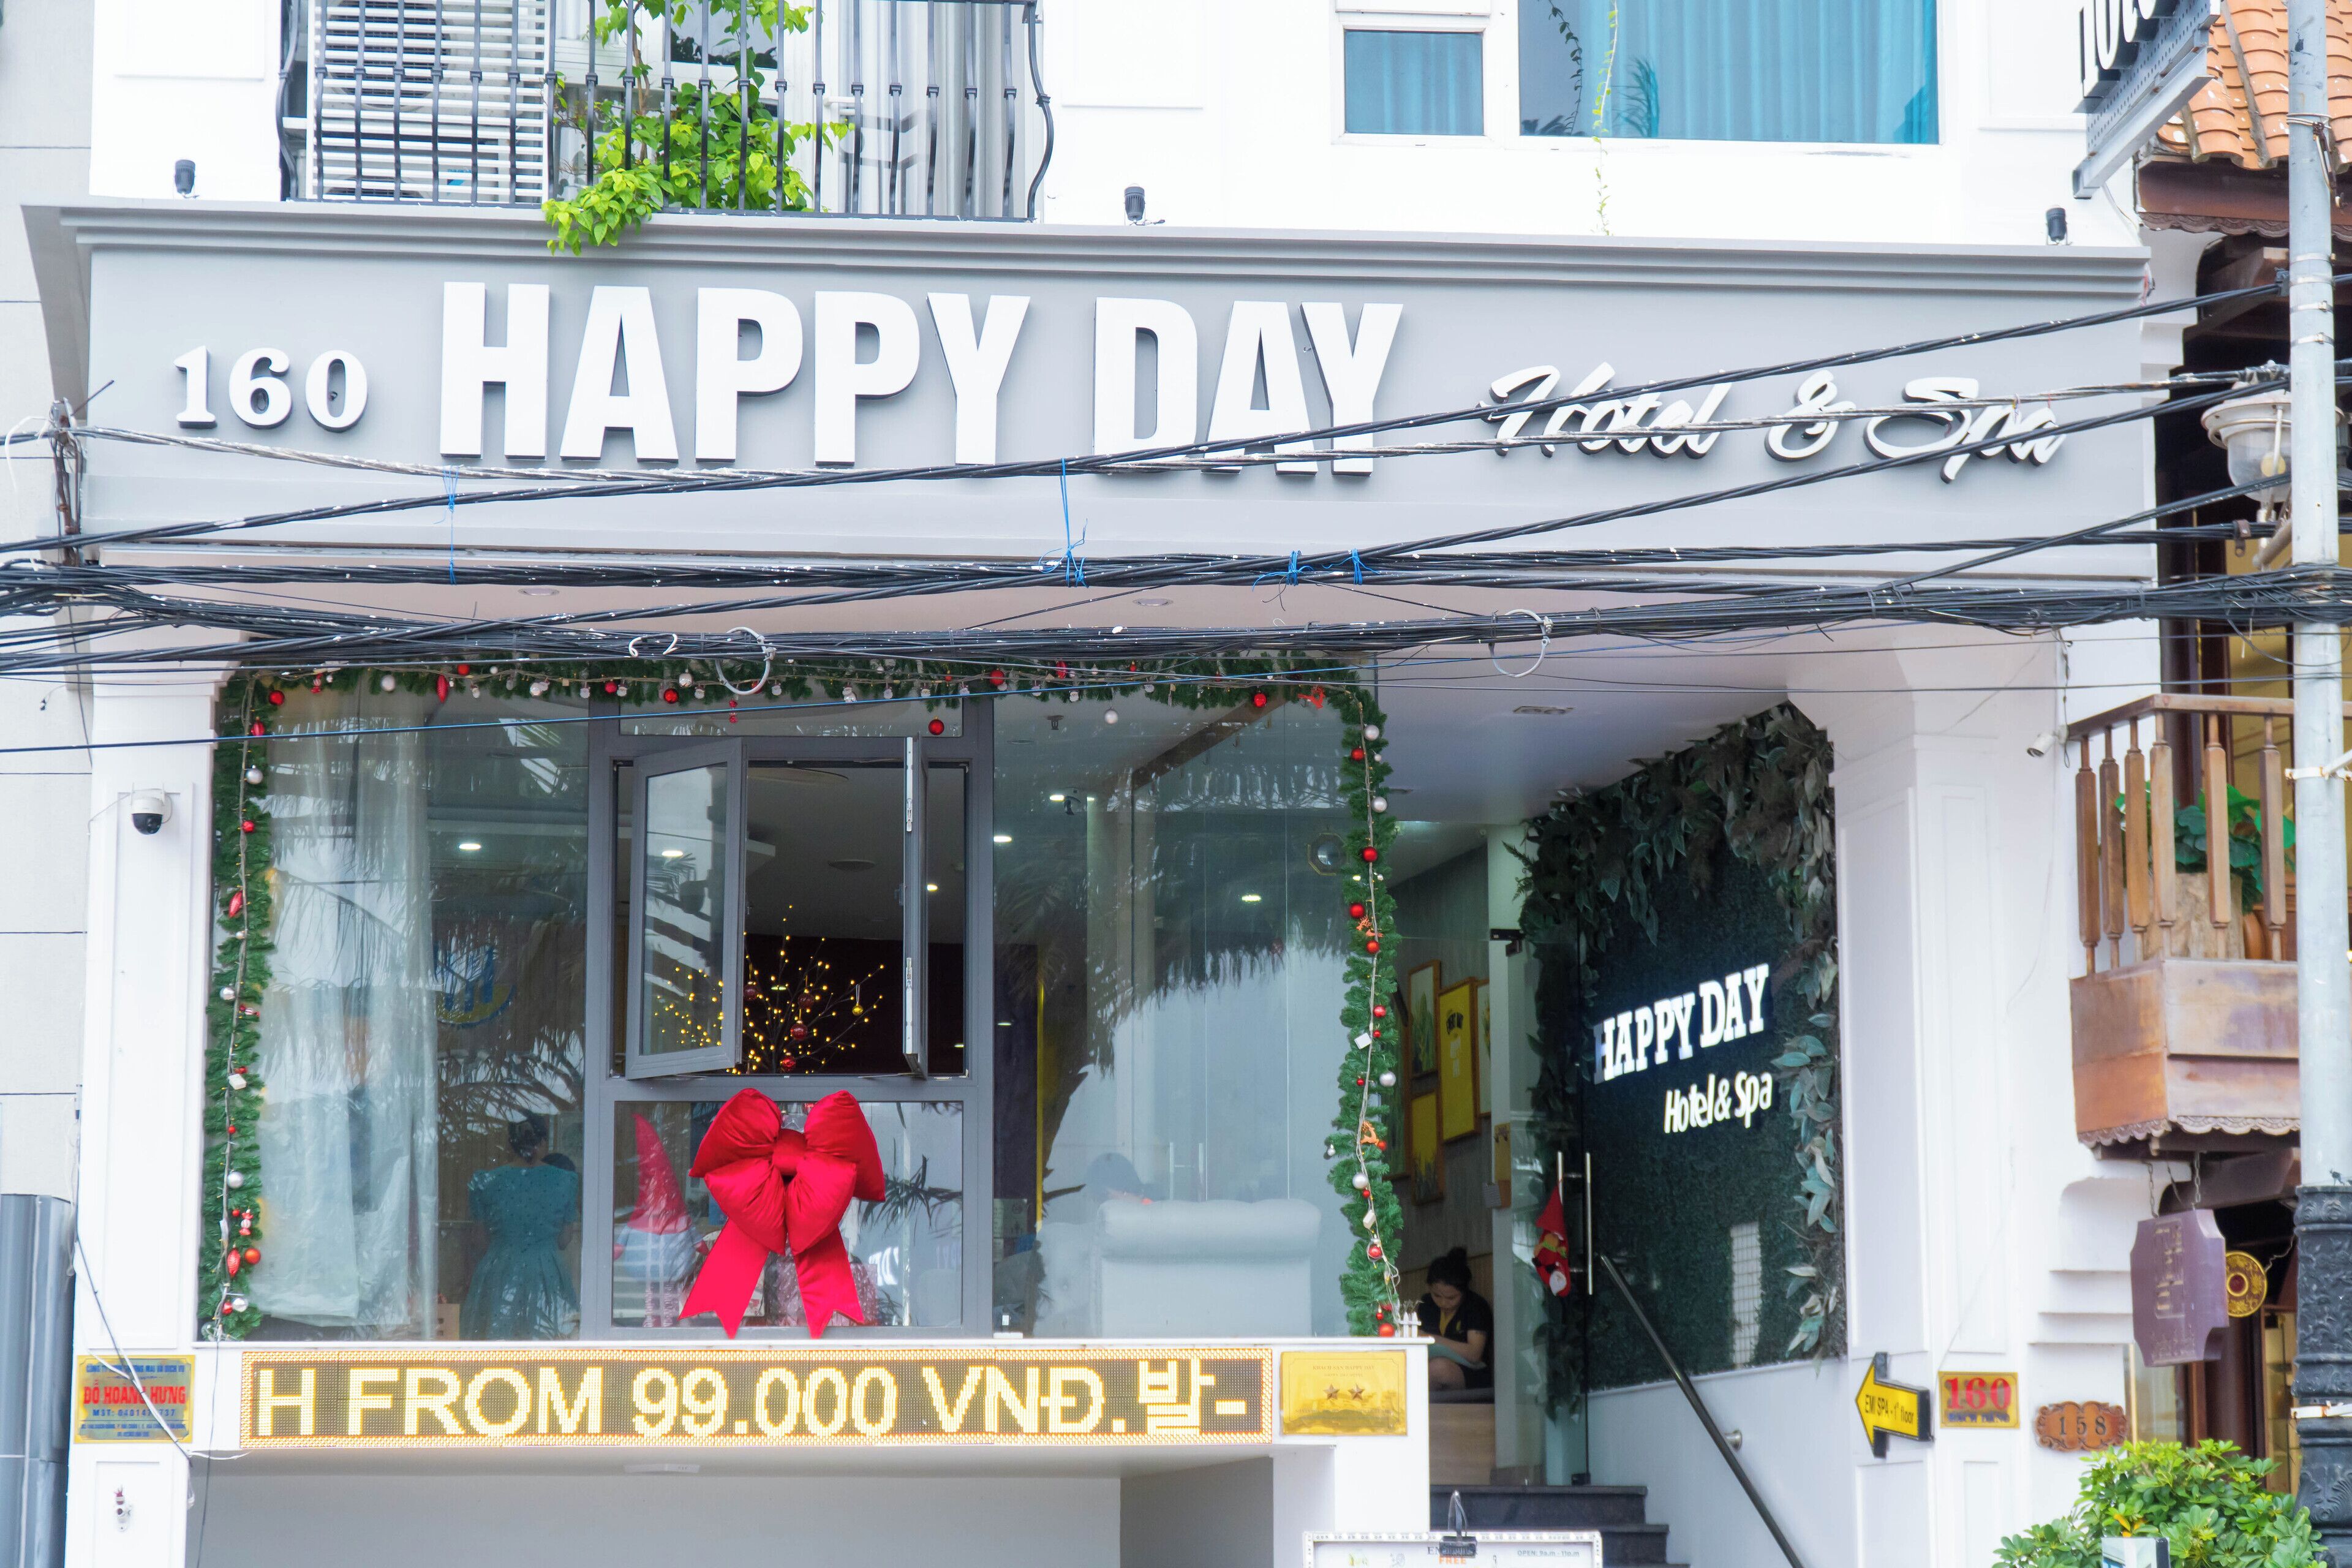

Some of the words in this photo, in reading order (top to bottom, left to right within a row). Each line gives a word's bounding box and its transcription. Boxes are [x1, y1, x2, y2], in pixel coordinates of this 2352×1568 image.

[173, 345, 368, 432] 160
[439, 281, 1031, 467] HAPPY
[1093, 296, 1403, 476] DAY
[1475, 361, 1733, 459] Hotel
[1765, 370, 1856, 462] &
[1863, 376, 2067, 484] Spa
[1593, 992, 1695, 1085] HAPPY
[1698, 963, 1770, 1048] DAY
[257, 1368, 316, 1436] H
[347, 1366, 604, 1438] FROM
[631, 1366, 897, 1438] 99.000
[1865, 1394, 1875, 1414] EMI
[1877, 1397, 1890, 1418] SPA
[1901, 1406, 1914, 1423] floor
[1947, 1377, 2011, 1410] 160
[2059, 1415, 2107, 1436] 158
